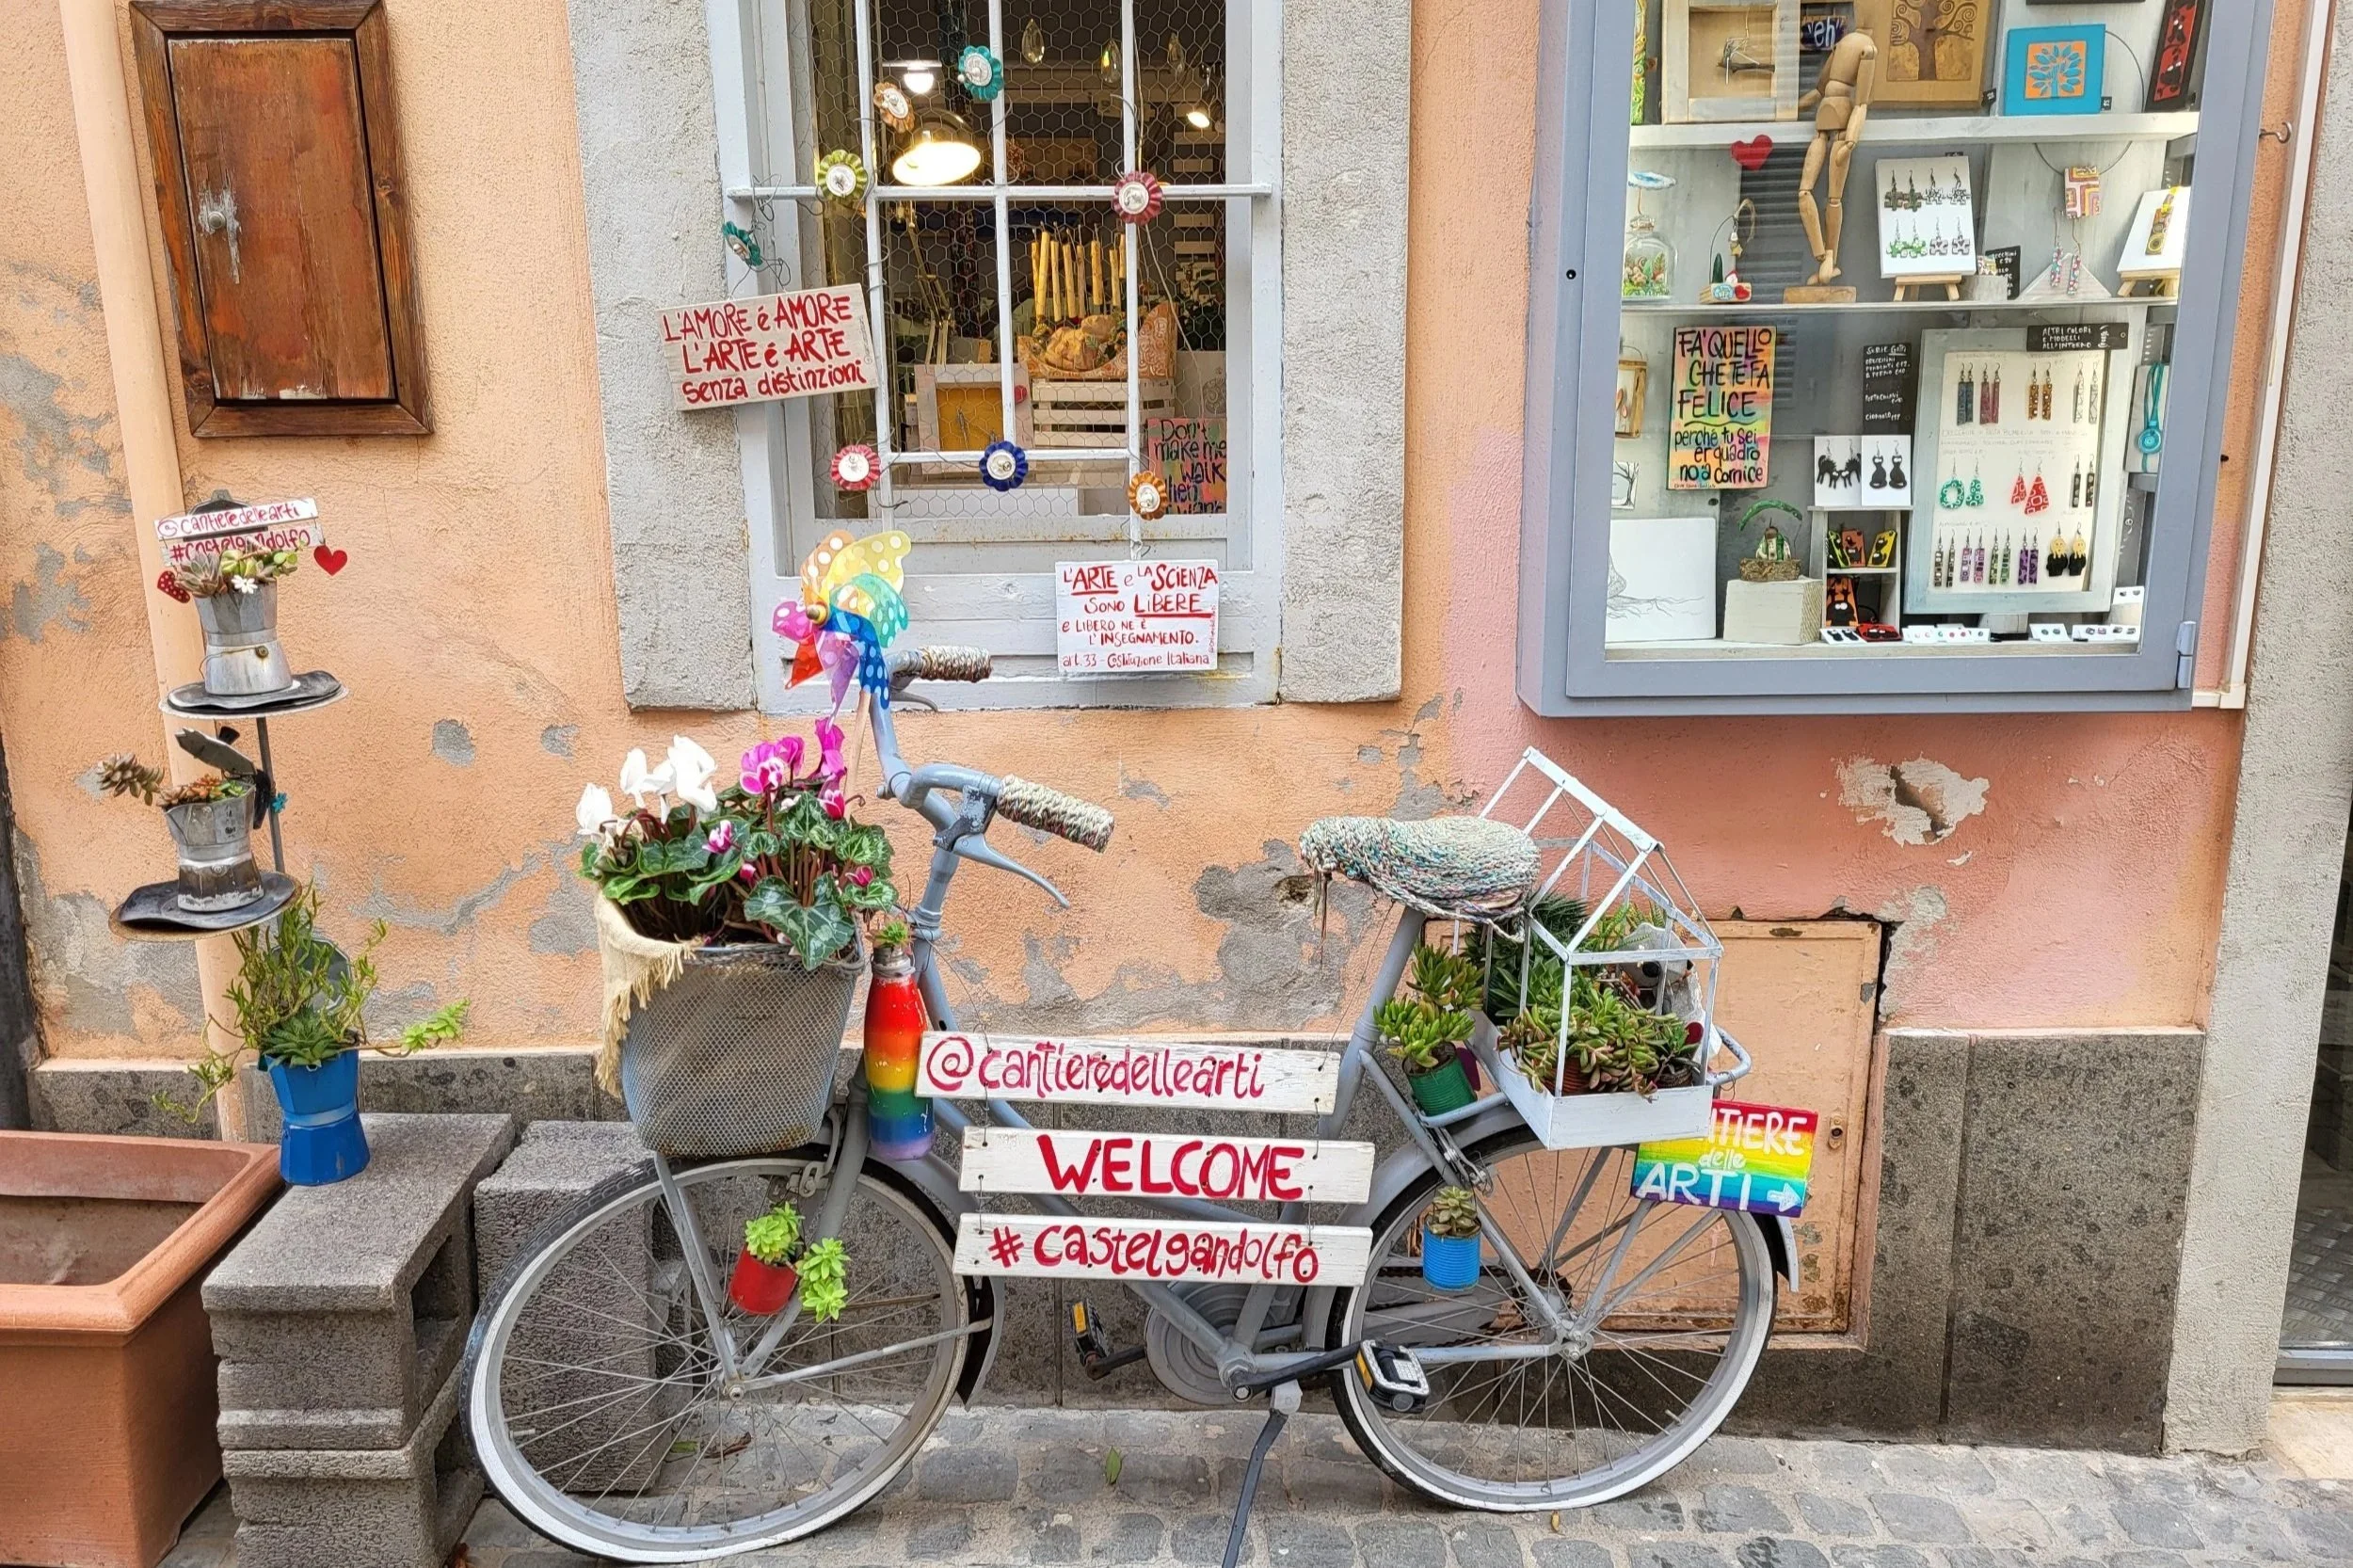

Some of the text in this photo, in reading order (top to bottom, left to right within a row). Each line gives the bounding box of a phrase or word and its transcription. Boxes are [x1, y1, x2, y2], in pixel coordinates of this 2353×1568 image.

[664, 303, 752, 342] L'AMORE
[774, 293, 853, 329] AMORE
[682, 342, 761, 374] L'ARTE
[784, 328, 852, 364] ARTE
[1707, 328, 1771, 360] QUELLO
[682, 360, 868, 404] senza distinzioni
[1689, 360, 1770, 389] CHE TE FA
[1678, 389, 1757, 420] FELICE
[1161, 419, 1208, 441] Don't
[1674, 427, 1718, 452] perché
[1721, 426, 1734, 444] tu
[1154, 440, 1226, 461] make me
[1694, 444, 1761, 467] er quadro
[1680, 464, 1699, 482] no
[1714, 466, 1763, 484] cornice
[157, 504, 300, 536] @cantieredellearti
[1064, 566, 1118, 591] L'ARTE
[1124, 573, 1134, 587] e
[1137, 566, 1152, 578] LA
[1062, 621, 1070, 632] e
[1076, 620, 1115, 632] LIBERO
[1121, 620, 1135, 631] NE
[1083, 653, 1097, 667] 33
[1167, 650, 1210, 665] Italiana
[926, 1036, 1265, 1099] @cantieredellearti
[1036, 1133, 1305, 1201] WELCOME
[1698, 1148, 1747, 1170] delle
[1635, 1162, 1752, 1211] ARTI
